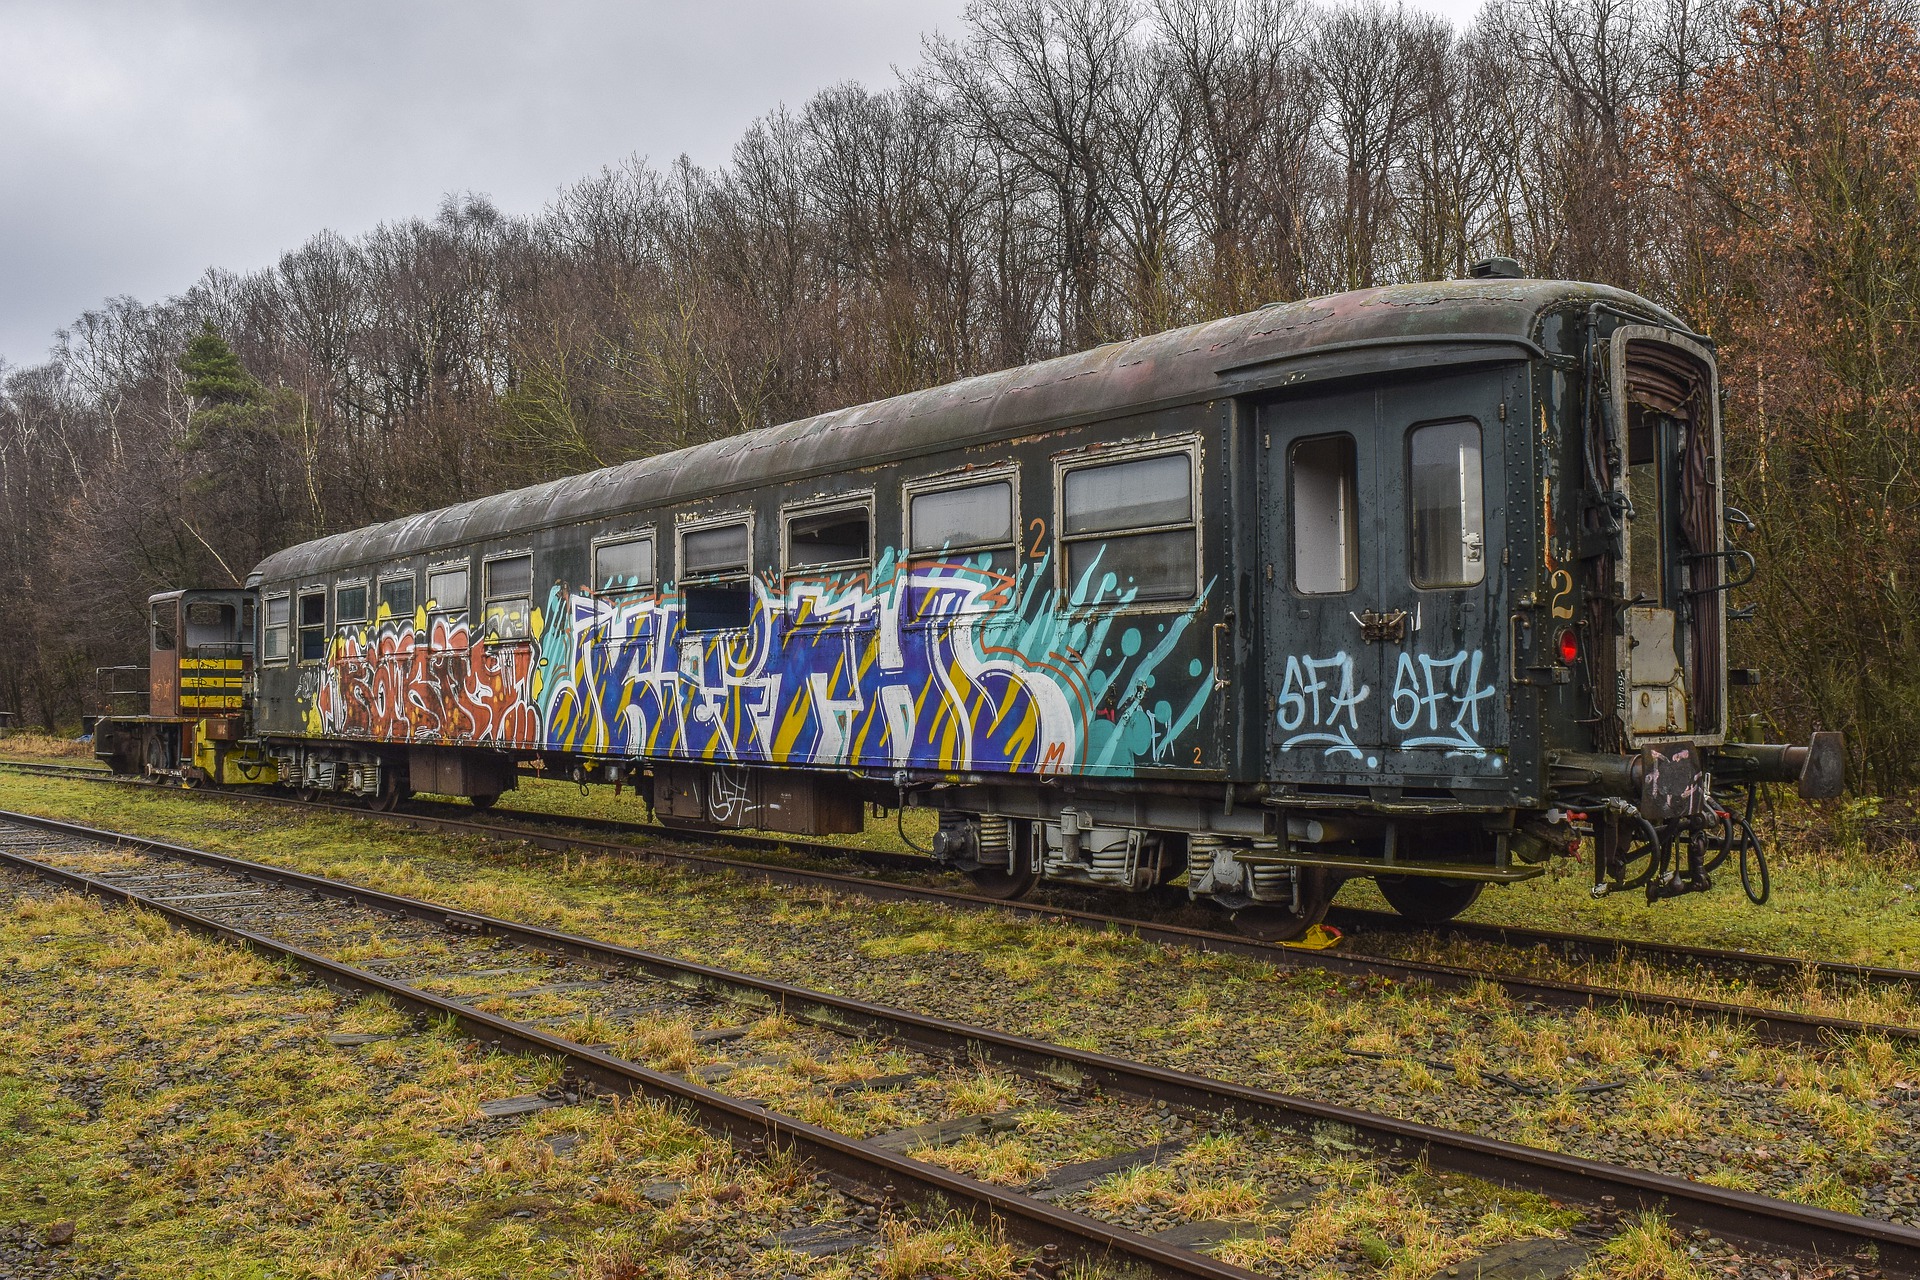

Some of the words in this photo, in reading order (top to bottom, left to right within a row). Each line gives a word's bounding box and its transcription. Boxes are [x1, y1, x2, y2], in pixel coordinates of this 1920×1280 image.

[1030, 518, 1046, 558] 2
[1551, 569, 1574, 619] 2
[1193, 746, 1203, 765] 2
